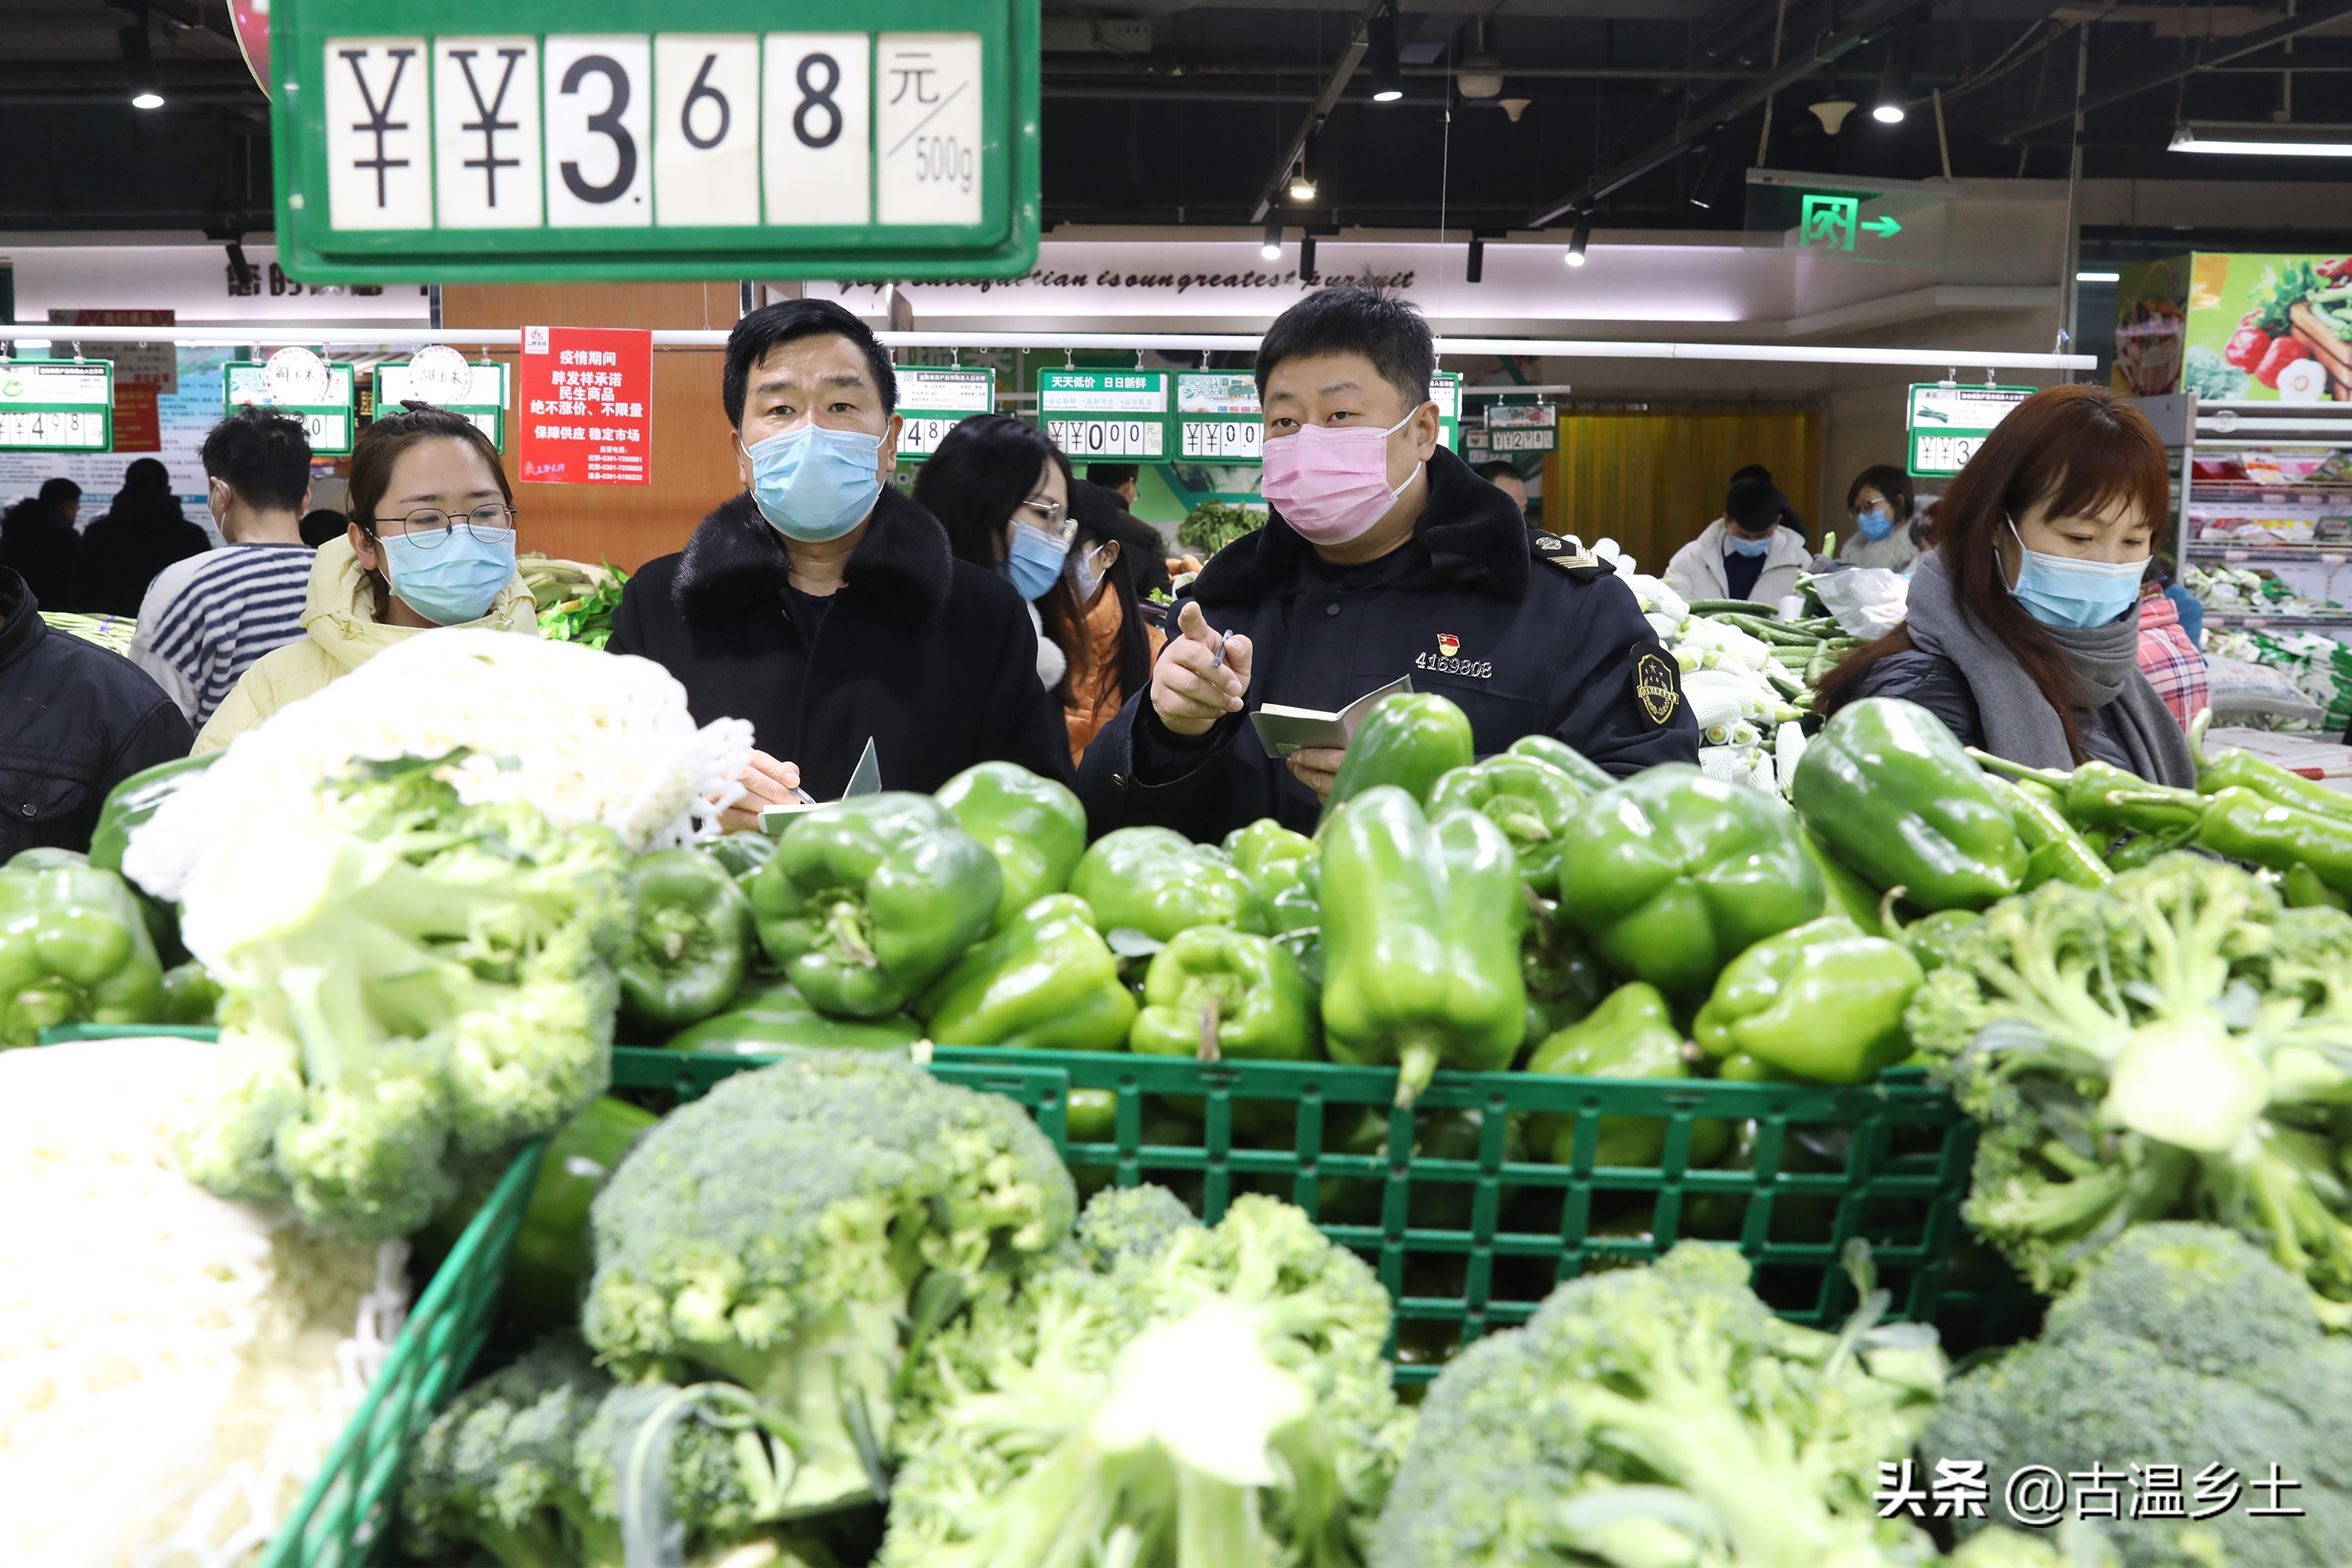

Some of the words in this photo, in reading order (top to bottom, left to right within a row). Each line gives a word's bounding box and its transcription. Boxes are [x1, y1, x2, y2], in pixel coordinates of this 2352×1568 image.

[560, 350, 616, 366] 疫情期间
[552, 371, 622, 387] 胖发祥承诺
[1051, 376, 1095, 388] 天天低价
[1104, 377, 1147, 388] 日日新鲜
[559, 387, 615, 401] 民生商品
[535, 426, 586, 440] 保障供应
[589, 427, 640, 442] 稳定市场
